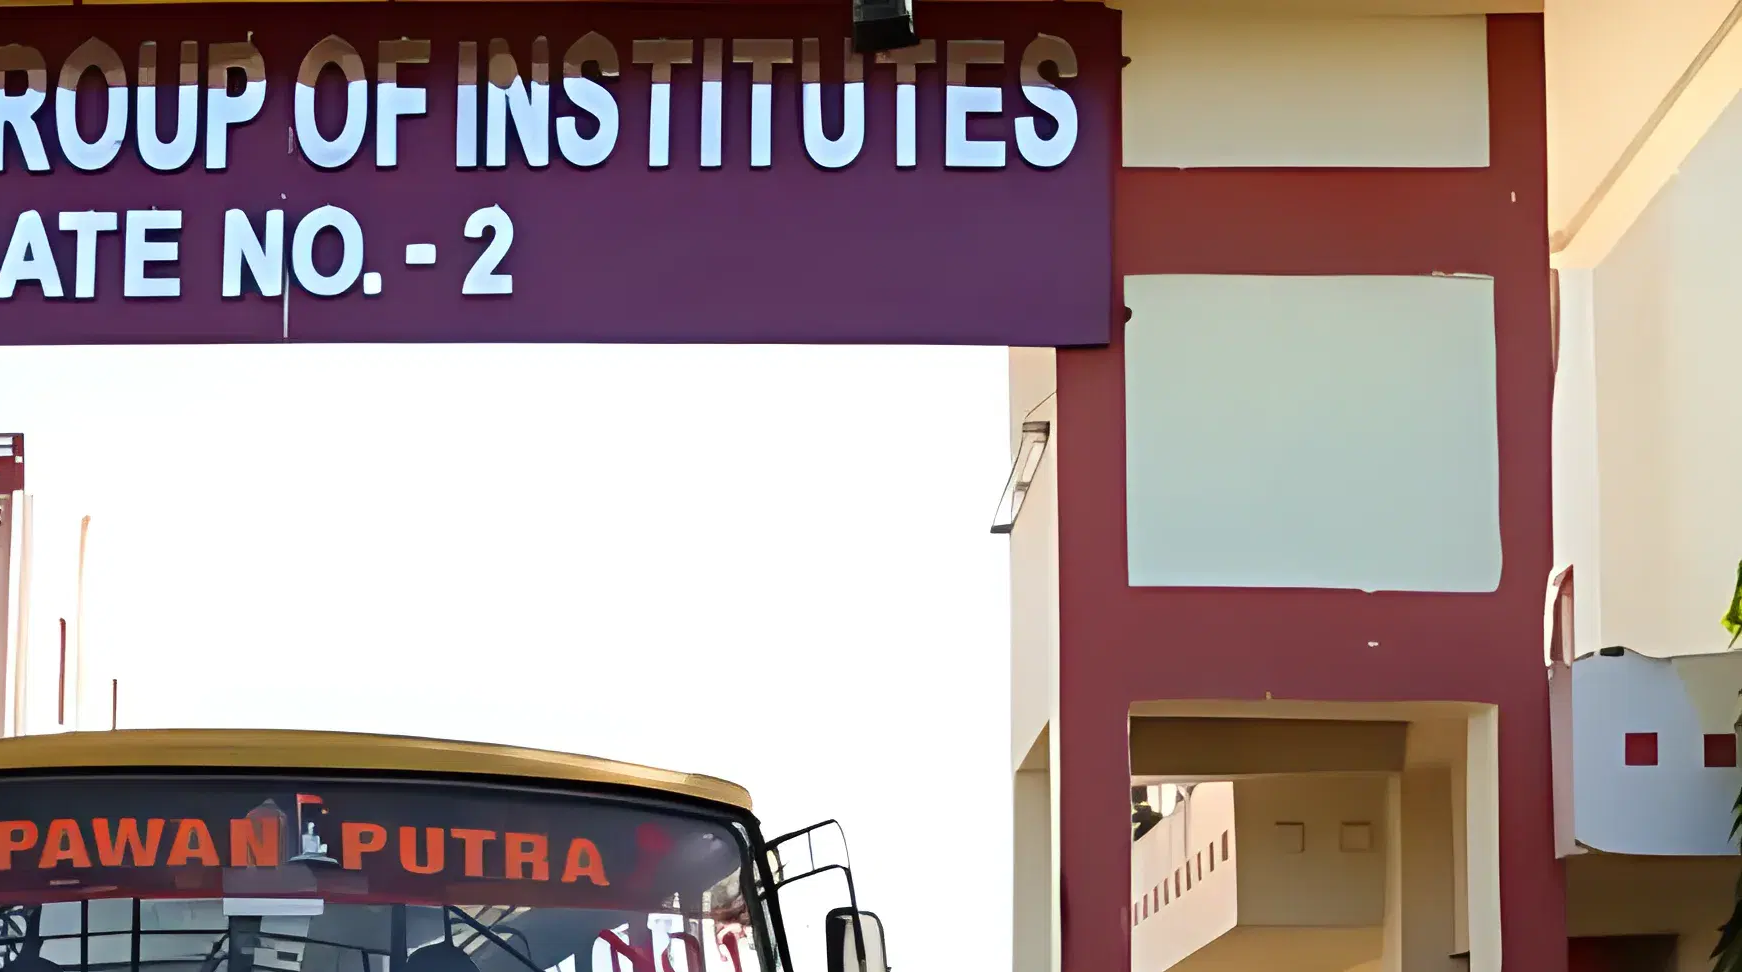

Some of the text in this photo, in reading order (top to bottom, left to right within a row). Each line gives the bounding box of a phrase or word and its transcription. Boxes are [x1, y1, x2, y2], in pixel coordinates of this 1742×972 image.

[294, 34, 431, 170] OF
[456, 31, 1078, 169] INSTITUTES
[222, 204, 382, 298] NO.
[462, 204, 514, 294] 2
[342, 821, 610, 887] PUTRA
